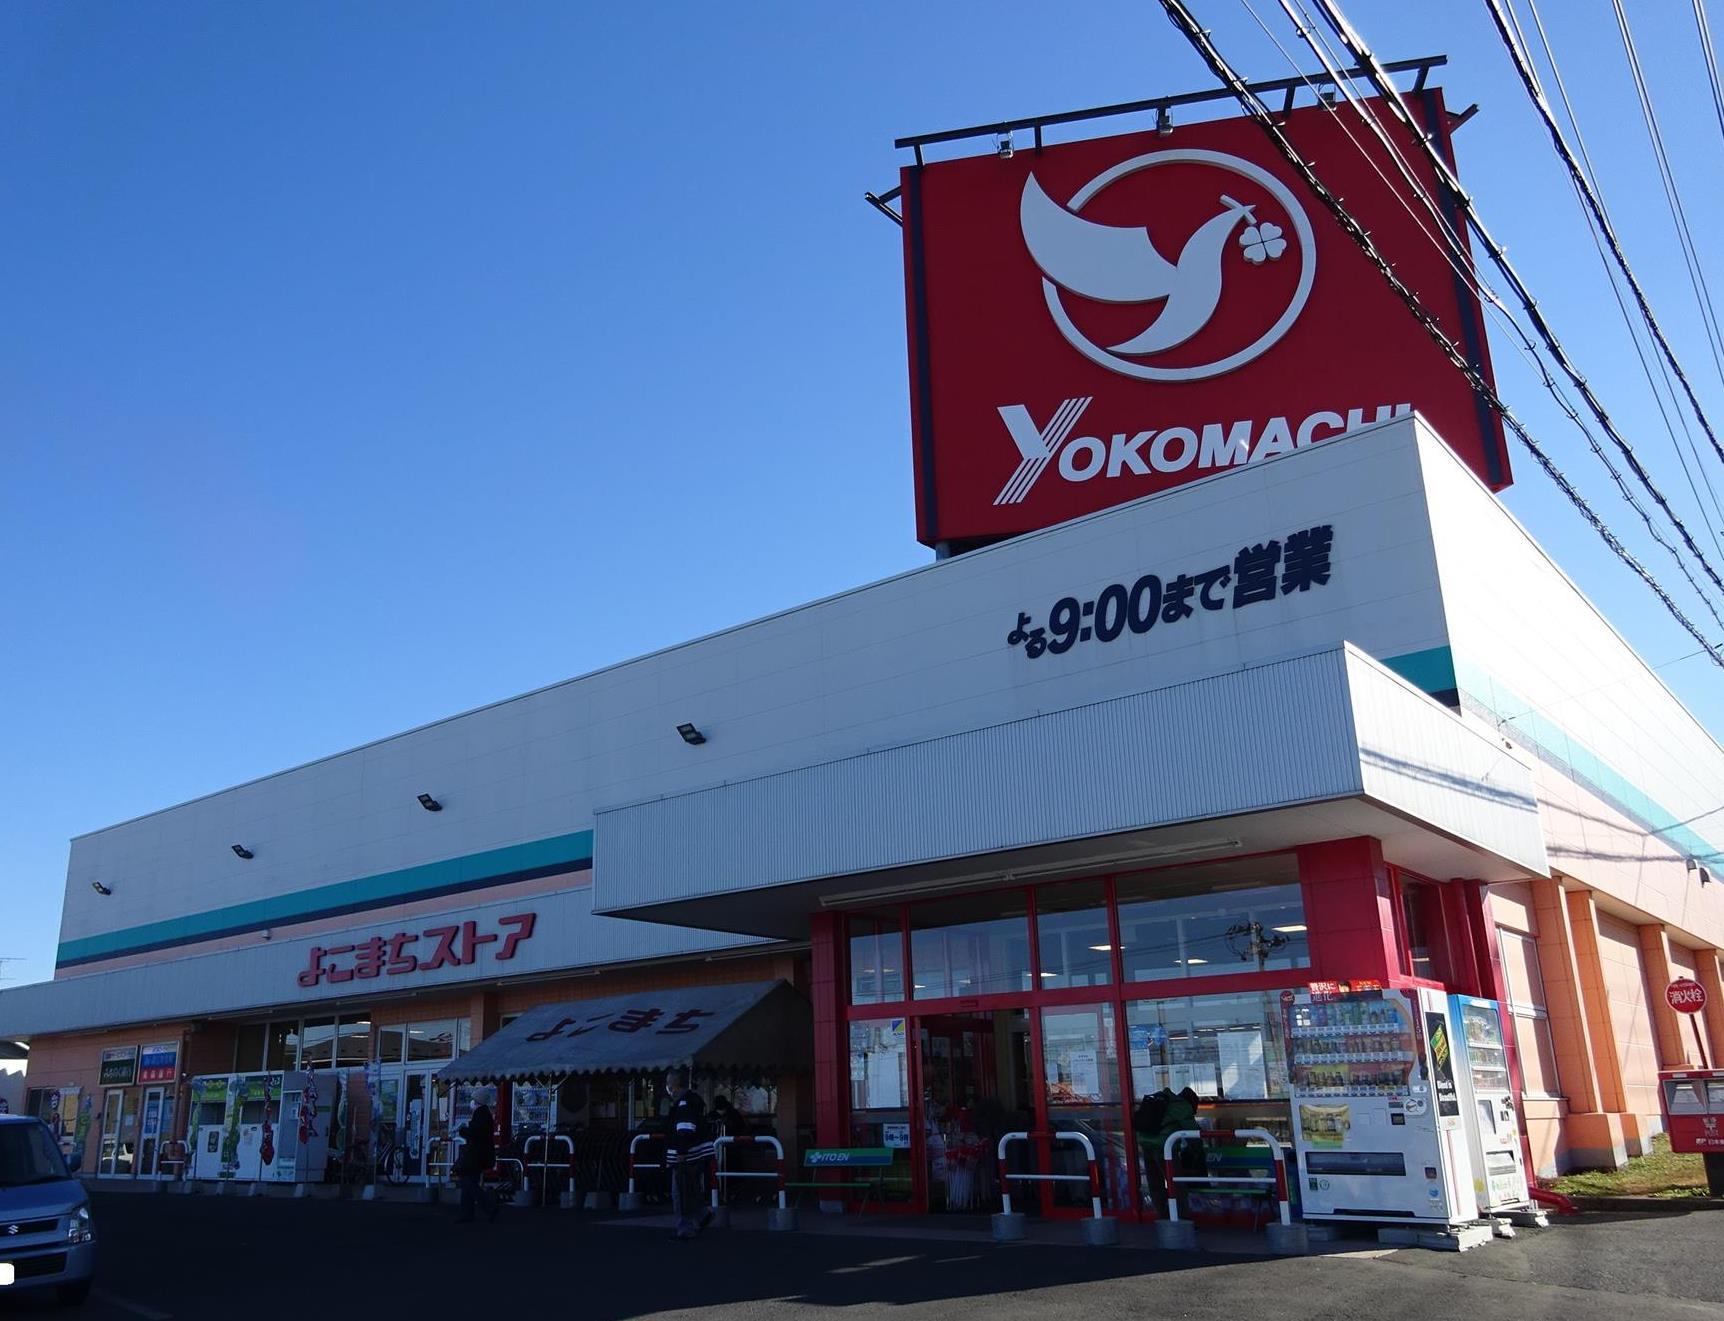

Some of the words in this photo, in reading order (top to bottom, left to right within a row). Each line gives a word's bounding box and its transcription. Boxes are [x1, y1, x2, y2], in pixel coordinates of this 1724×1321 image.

[1007, 524, 1334, 660] よる9:00まで営業
[297, 912, 537, 988] よこまちストア
[1668, 988, 1704, 1005] 消火栓
[526, 1008, 715, 1043] よこまち
